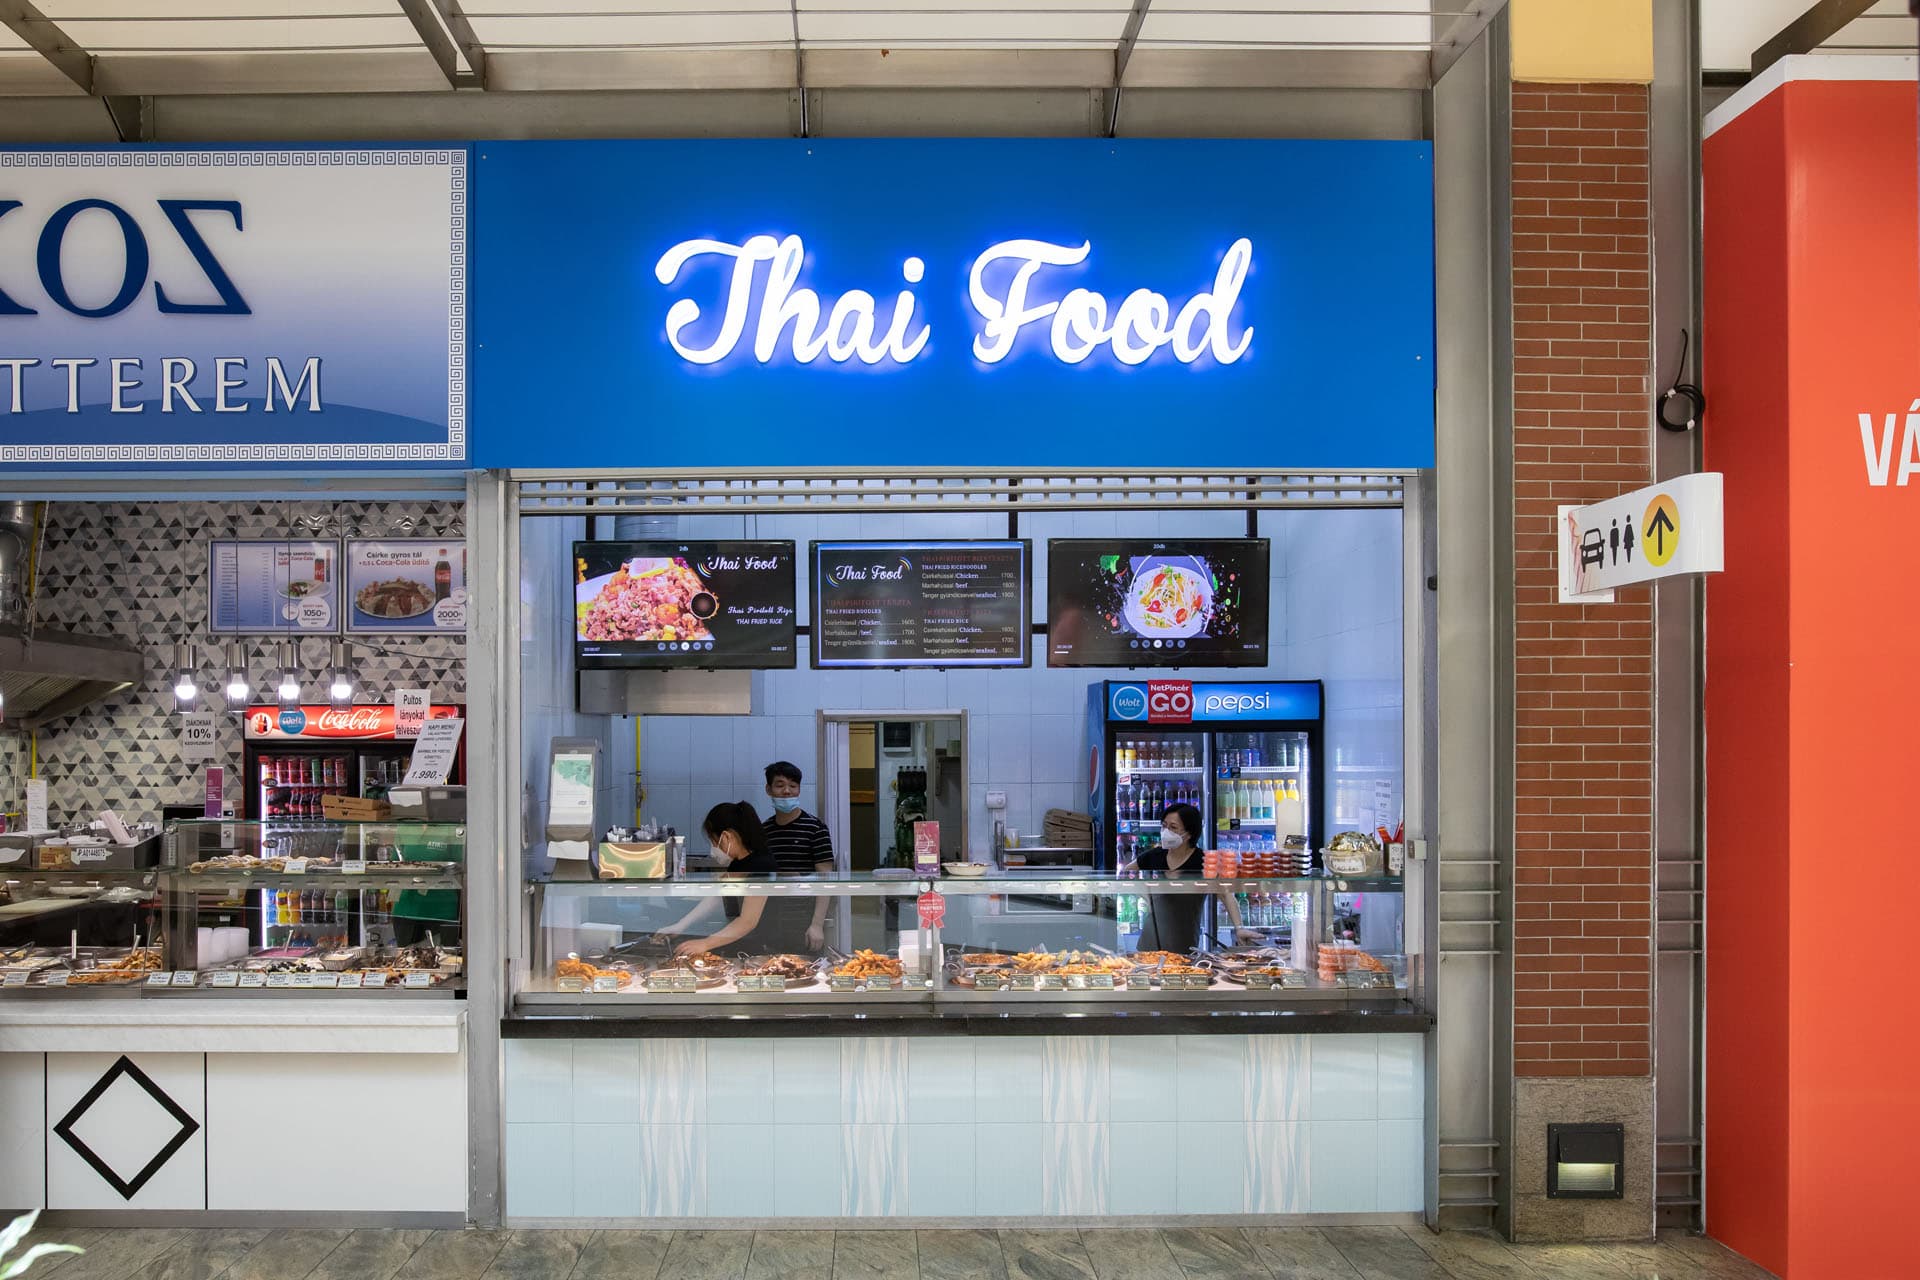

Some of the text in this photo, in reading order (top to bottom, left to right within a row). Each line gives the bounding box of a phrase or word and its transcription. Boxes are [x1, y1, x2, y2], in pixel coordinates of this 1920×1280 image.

[655, 234, 1254, 364] Thai Food
[707, 556, 778, 570] Thai Food
[836, 565, 903, 580] Thai Food
[1150, 684, 1189, 692] NetPincér
[1118, 698, 1140, 707] Wolt
[1151, 692, 1190, 712] GO
[1205, 691, 1270, 714] pepsi
[319, 708, 384, 730] Coca-Cola
[187, 728, 211, 739] 10%
